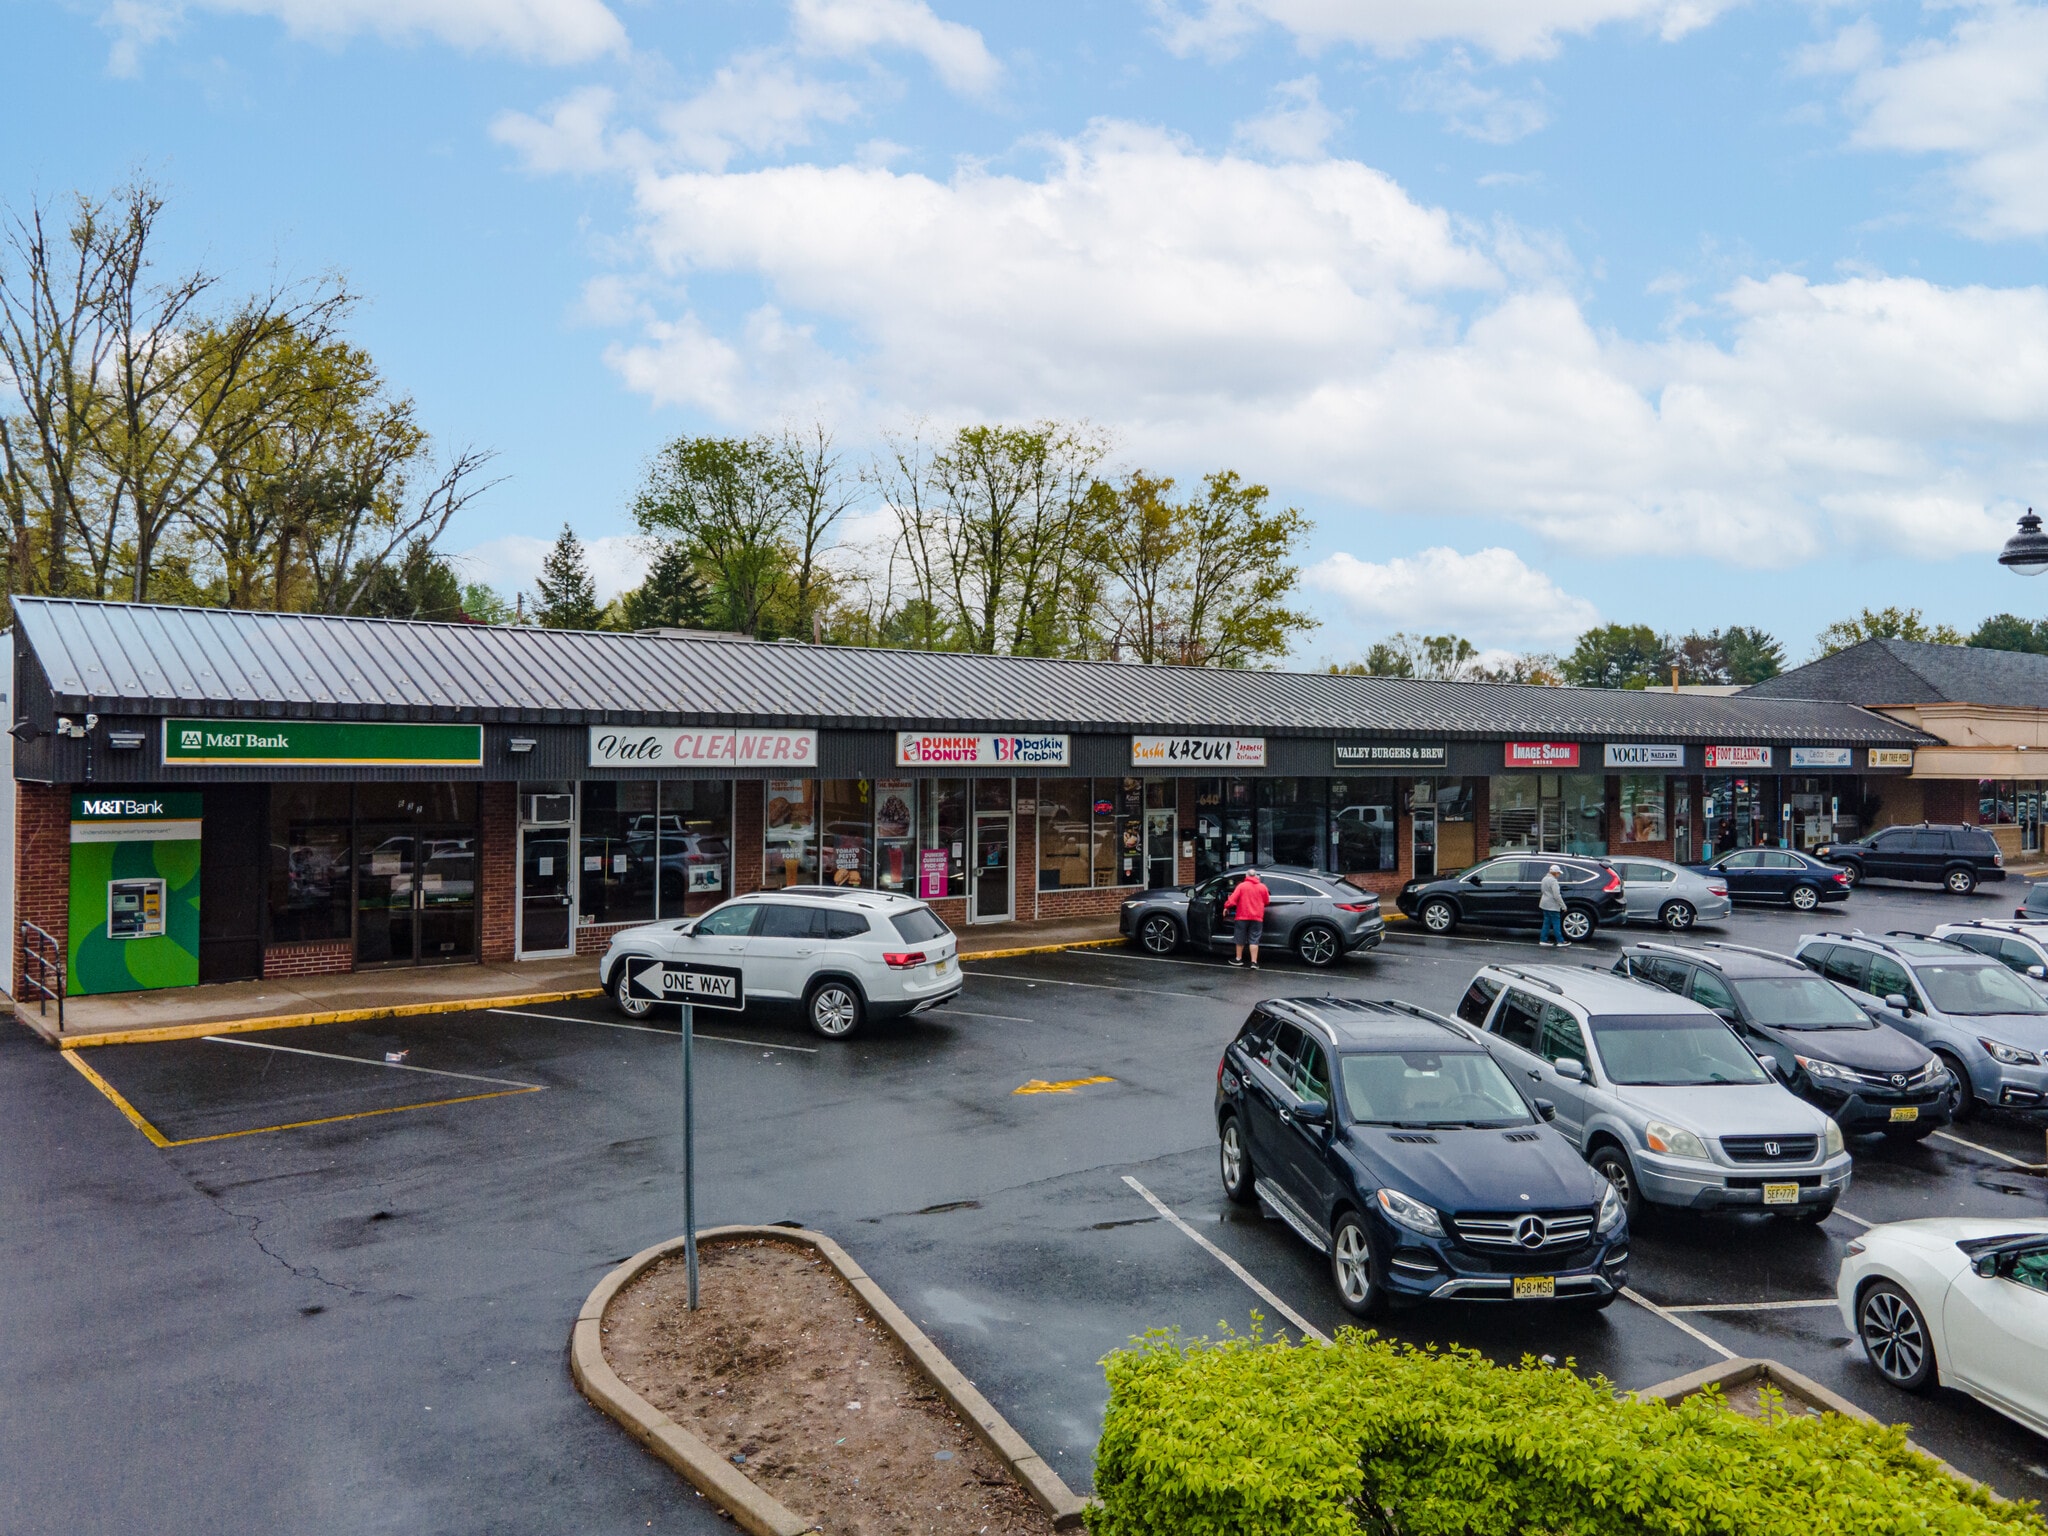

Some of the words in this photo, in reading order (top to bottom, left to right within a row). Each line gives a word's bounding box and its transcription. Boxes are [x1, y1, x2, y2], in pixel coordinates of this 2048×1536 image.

[206, 733, 245, 748] M&T
[246, 734, 289, 748] Bank
[597, 734, 663, 760] Vale
[673, 734, 811, 760] CLEANERS
[922, 737, 980, 749] DUNKIN'
[1023, 737, 1063, 750] baskin
[922, 749, 978, 761] DONUTS
[1023, 750, 1063, 762] robbins
[1133, 741, 1165, 759] Sushi
[1168, 740, 1231, 760] KAZUKI
[1337, 747, 1370, 758] VALLEY
[1371, 747, 1411, 758] BURGERS
[1412, 748, 1420, 758] &
[1420, 748, 1444, 758] BREW
[1612, 747, 1649, 762] VOGUE
[1717, 747, 1731, 760] FOOT
[1733, 747, 1760, 760] RELAXING
[1889, 752, 1898, 762] TREE
[1200, 794, 1220, 806] 640
[82, 800, 125, 815] M&T
[125, 800, 164, 814] Bank
[663, 973, 694, 991] ONE
[700, 976, 731, 995] WAY
